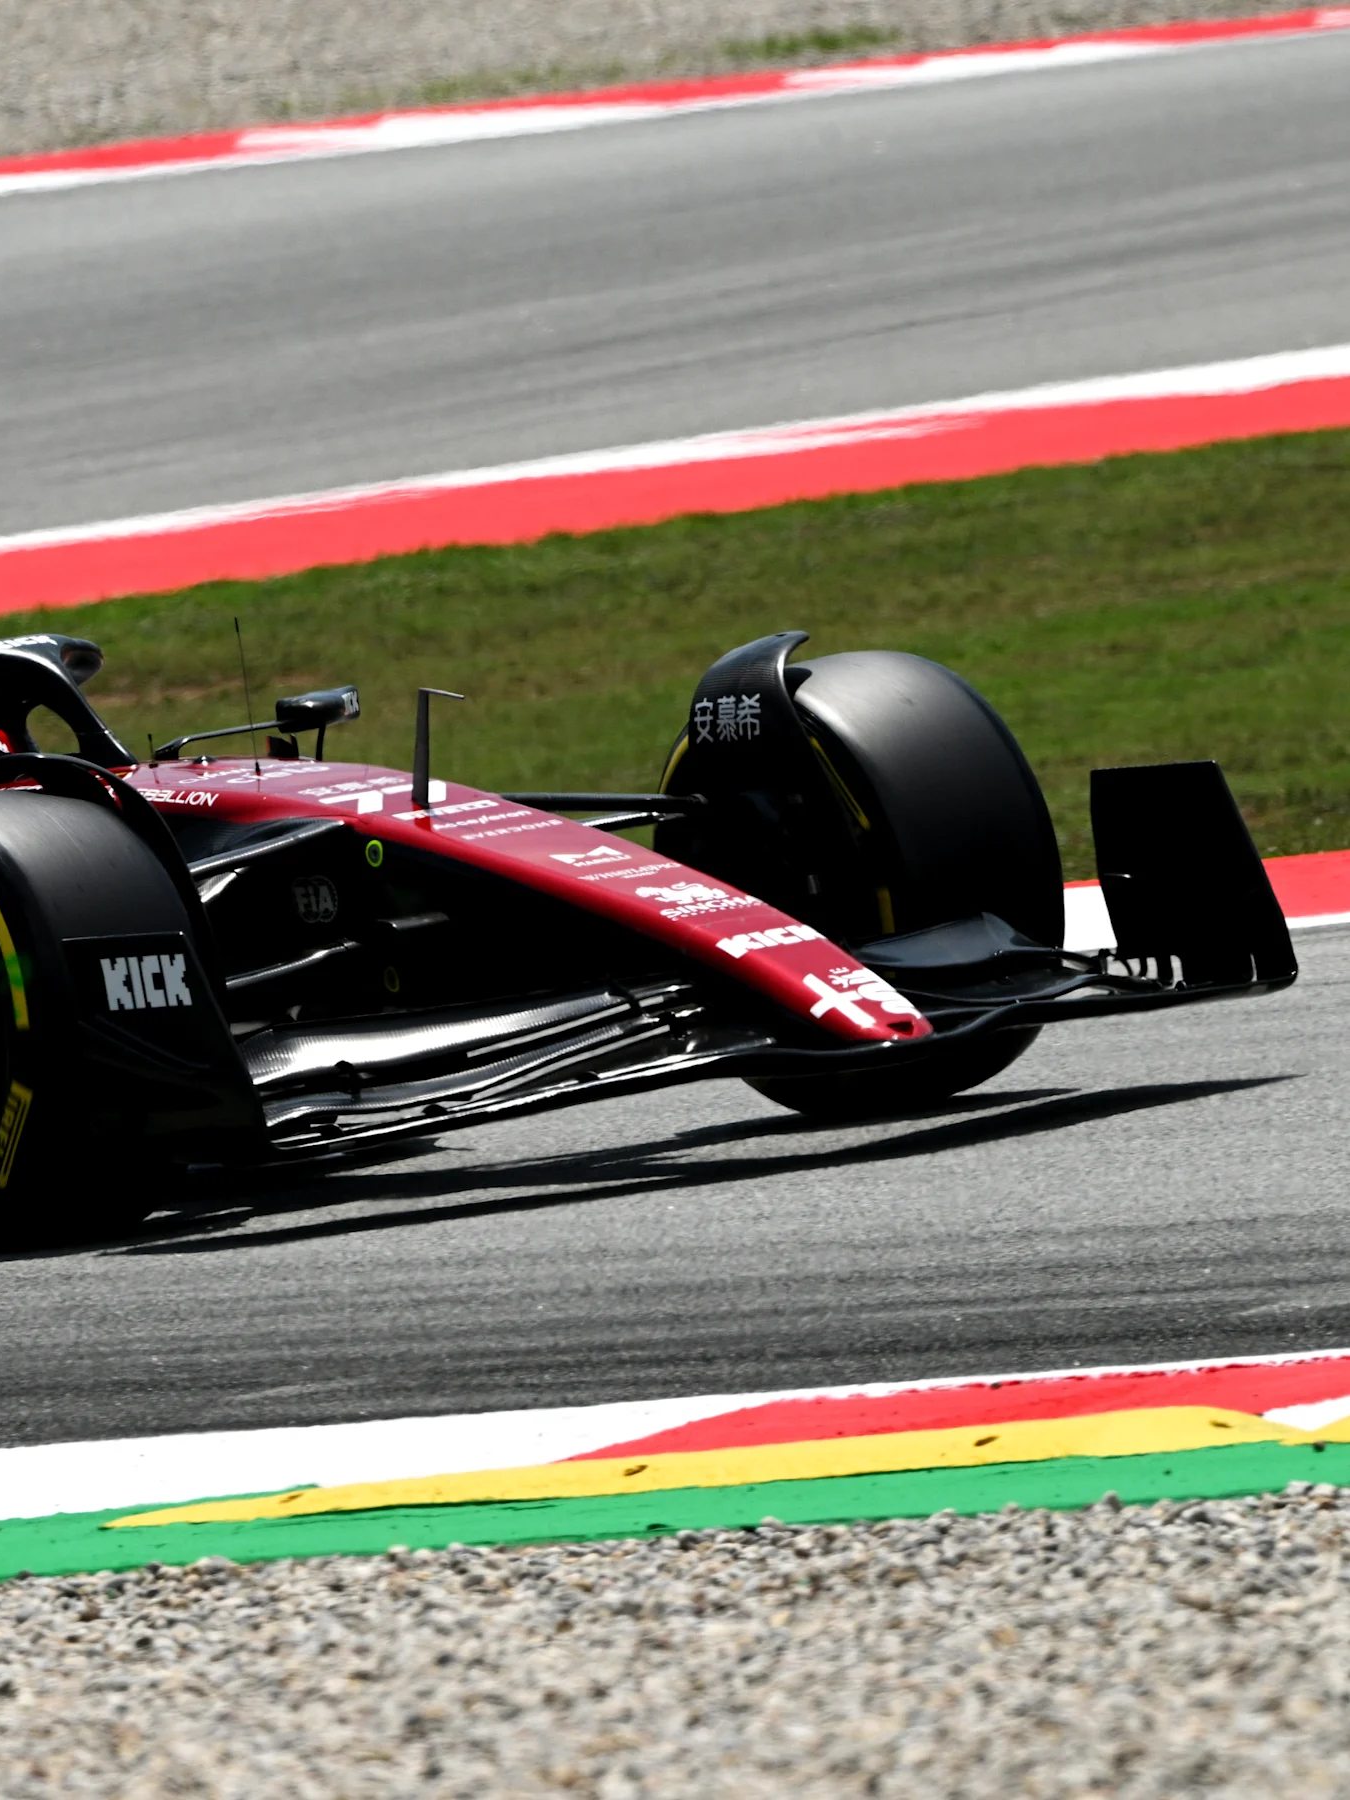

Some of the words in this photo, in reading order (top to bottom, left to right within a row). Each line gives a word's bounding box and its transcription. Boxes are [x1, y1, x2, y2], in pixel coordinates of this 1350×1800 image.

[693, 692, 762, 744] 安慕希
[715, 924, 828, 959] KICK
[100, 952, 194, 1012] KICK
